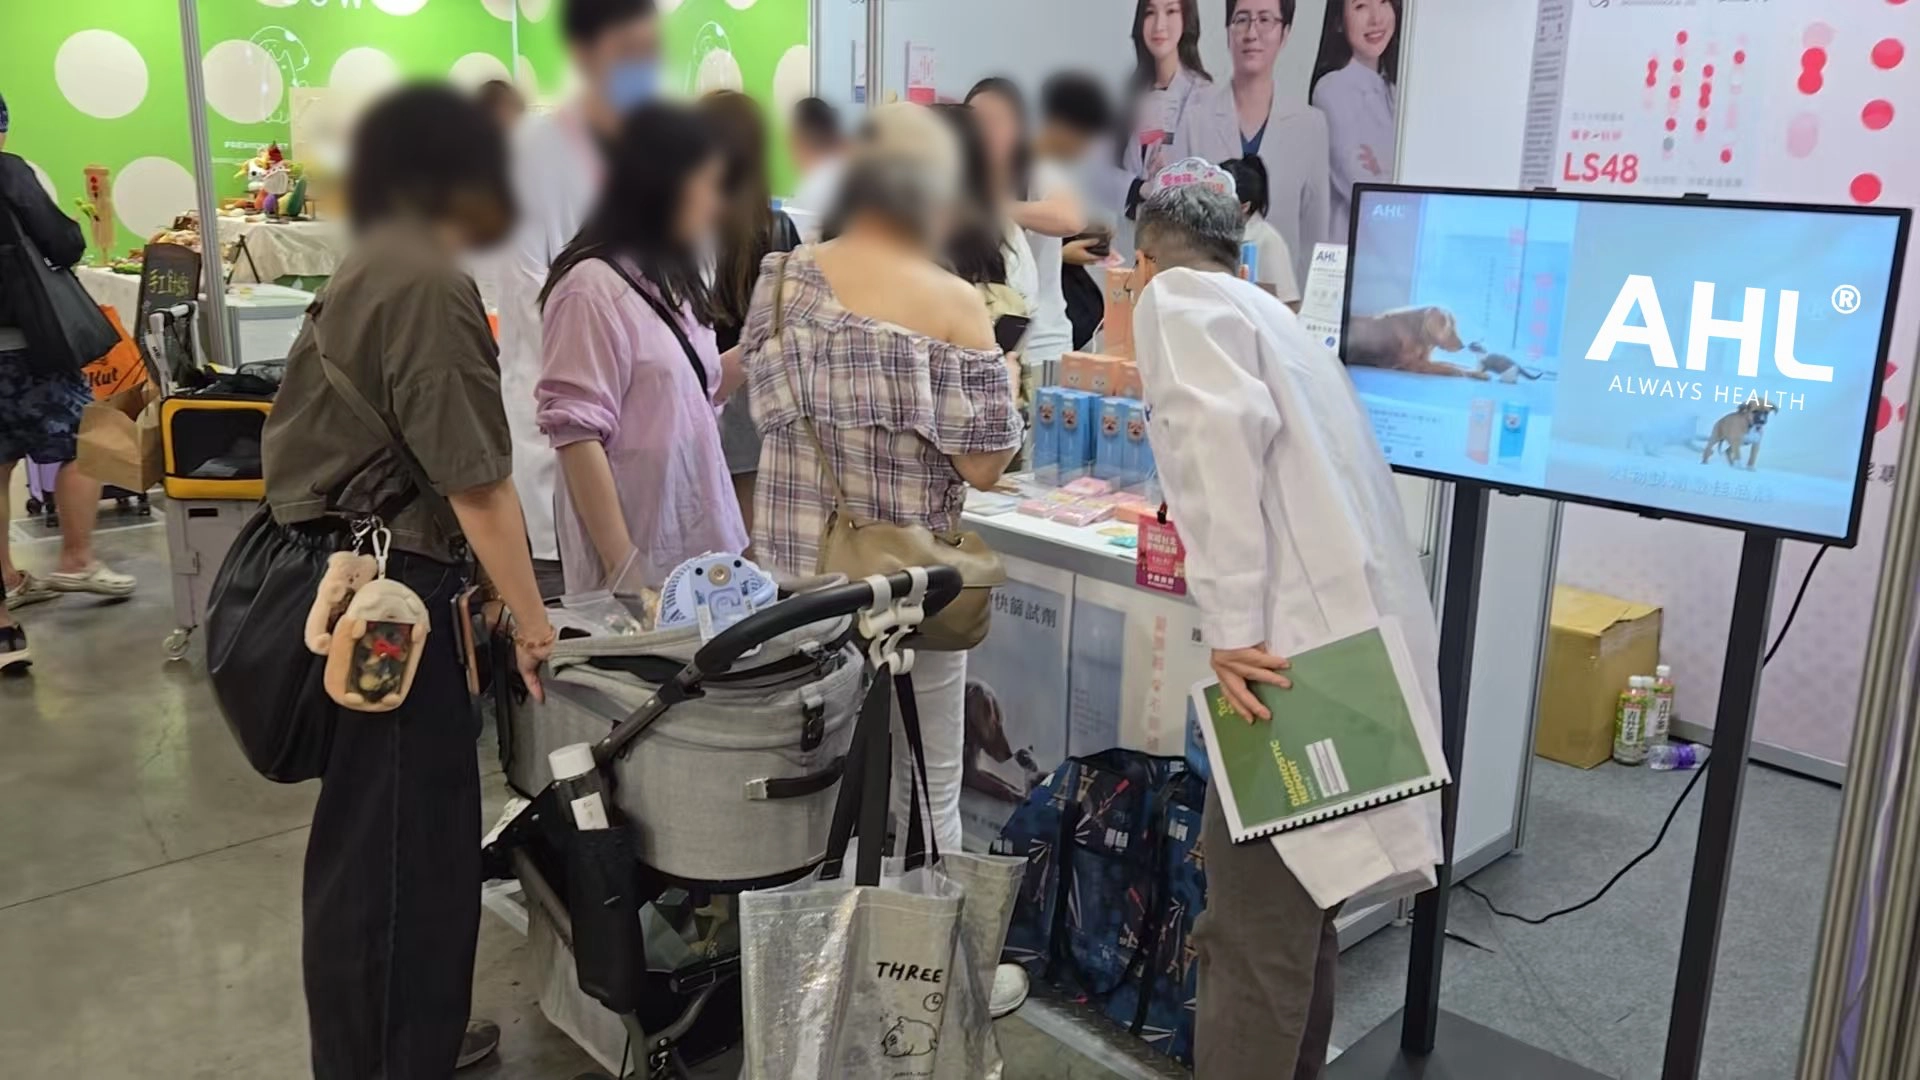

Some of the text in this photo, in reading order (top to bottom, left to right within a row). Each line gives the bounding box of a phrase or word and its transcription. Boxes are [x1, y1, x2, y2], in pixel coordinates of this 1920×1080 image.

[1564, 152, 1639, 184] LS48
[1372, 204, 1406, 217] AHL
[1316, 251, 1338, 263] AHL
[1608, 375, 1806, 411] ALWAYS HEALTH
[990, 591, 1057, 629] 快篩試劑
[876, 962, 943, 983] THREE
